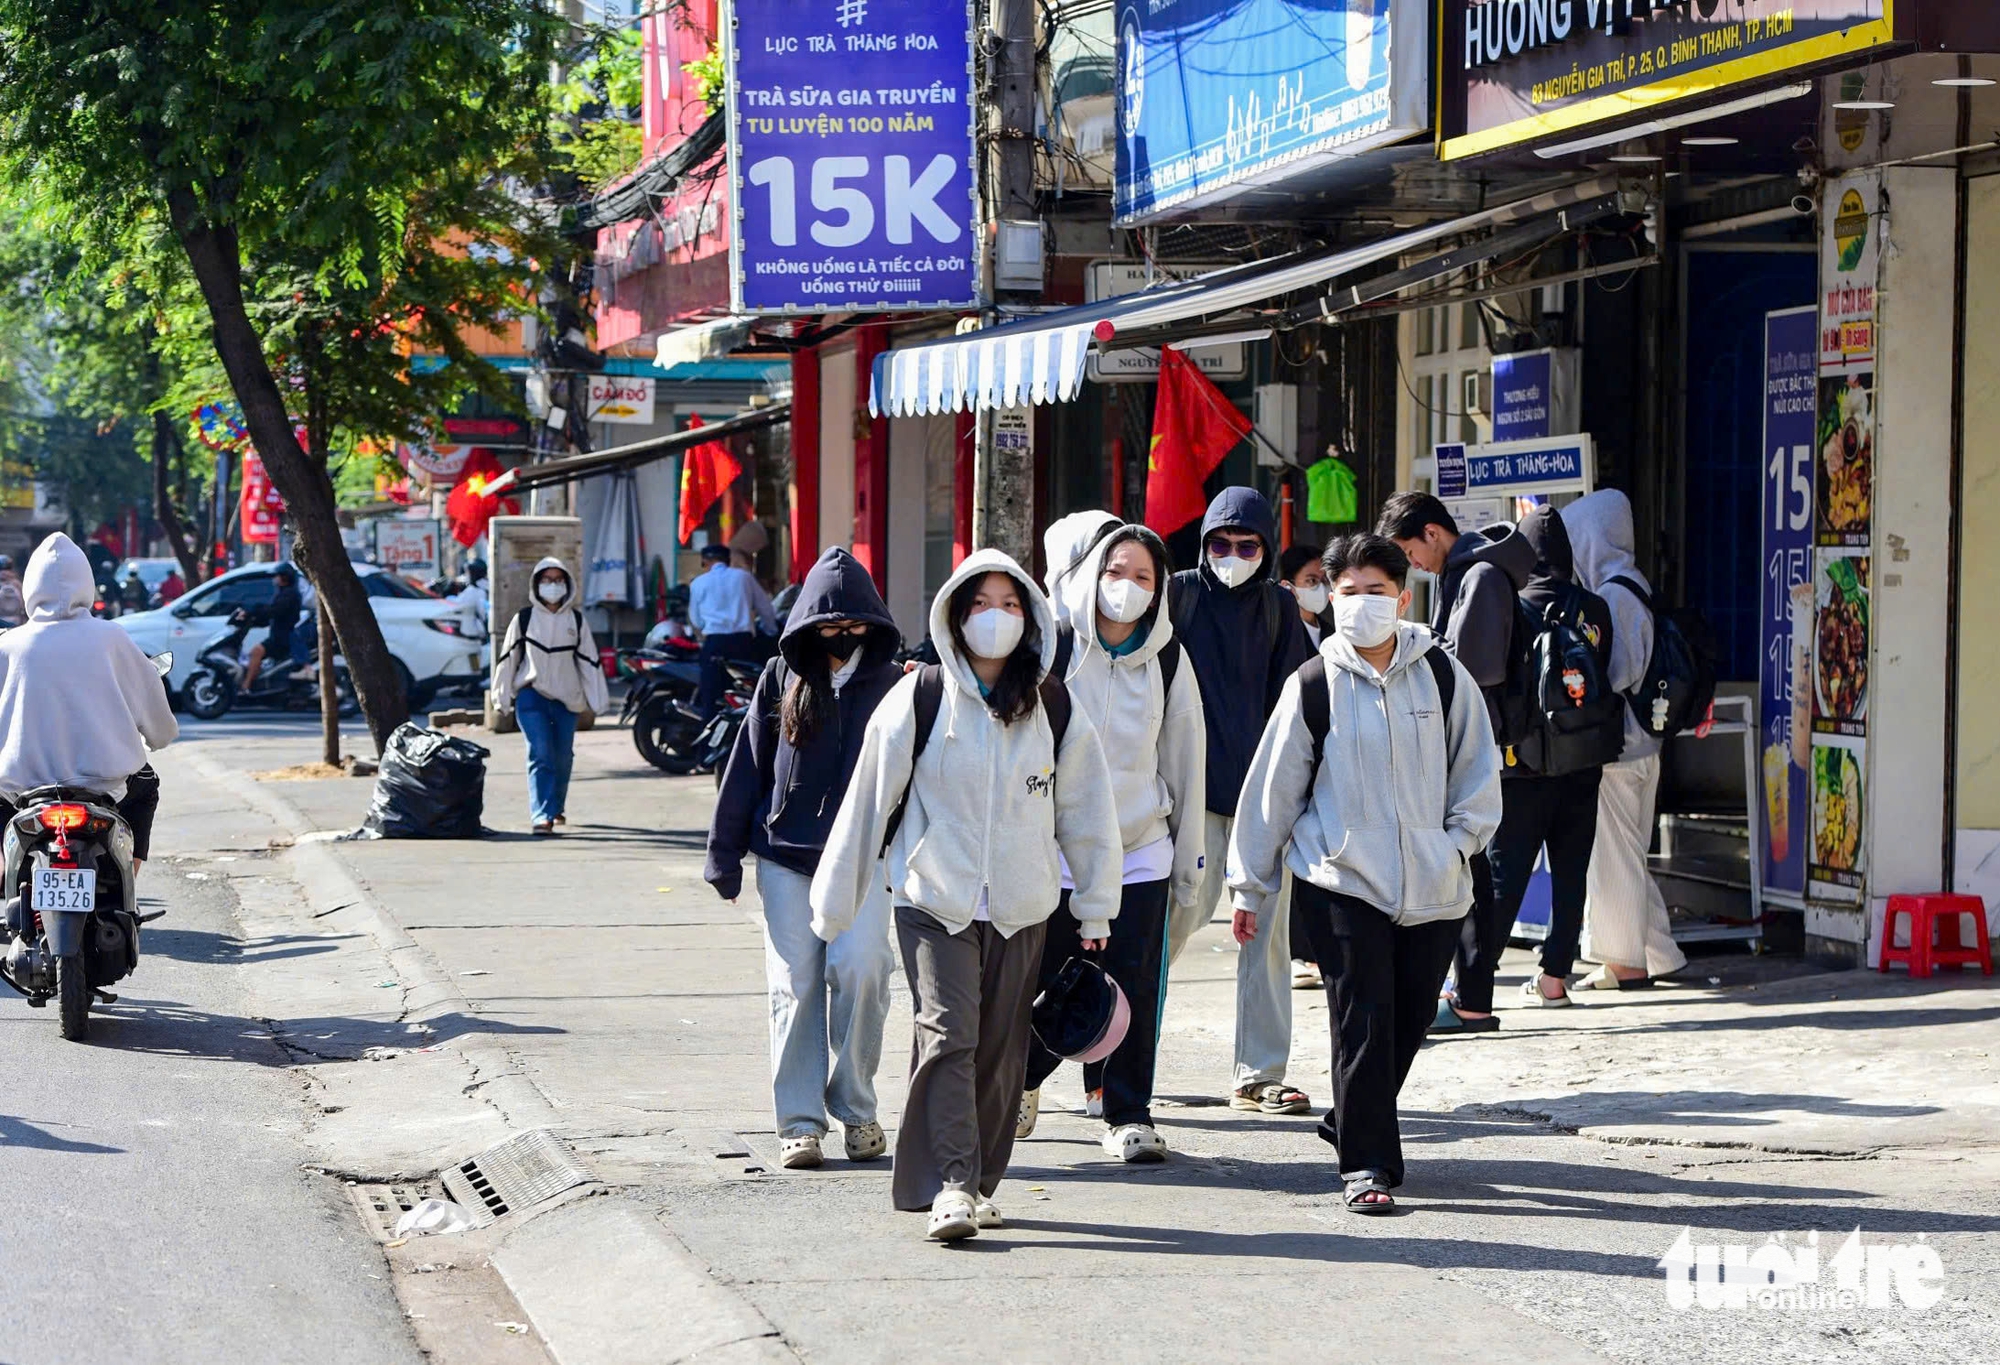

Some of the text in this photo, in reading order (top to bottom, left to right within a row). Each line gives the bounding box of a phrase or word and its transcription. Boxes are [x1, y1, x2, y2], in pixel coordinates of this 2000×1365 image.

[765, 33, 938, 55] LỤC TRÀ THĂNG HOA
[1531, 82, 1543, 105] 83
[1544, 62, 1585, 101] NGUYỄN
[1587, 65, 1605, 89] GIA
[1606, 52, 1626, 83] TRÍ,
[1628, 56, 1638, 77] P.
[1640, 50, 1654, 74] 25,
[1656, 46, 1668, 69] Q.
[1671, 34, 1697, 65] BÌNH
[1700, 24, 1742, 56] THẠNH,
[1745, 18, 1763, 44] TP.
[1766, 8, 1794, 39] HCM
[745, 80, 956, 107] TRÀ SỮA GIA TRUYỀN
[747, 112, 934, 138] TU LUYỆN 100 NĂM
[749, 154, 962, 247] 15K
[755, 255, 965, 275] KHÔNG UỐNG LÀ TIẾC CẢ ĐỜI
[1127, 270, 1161, 279] HAR
[801, 275, 845, 294] UỐNG
[848, 276, 880, 294] THỬ
[1787, 397, 1801, 413] CAO
[1469, 460, 1489, 482] LỤC
[1493, 457, 1512, 477] TRÀ
[1552, 452, 1575, 473] HOA
[43, 872, 84, 889] 95-EA
[37, 891, 91, 908] 135.26
